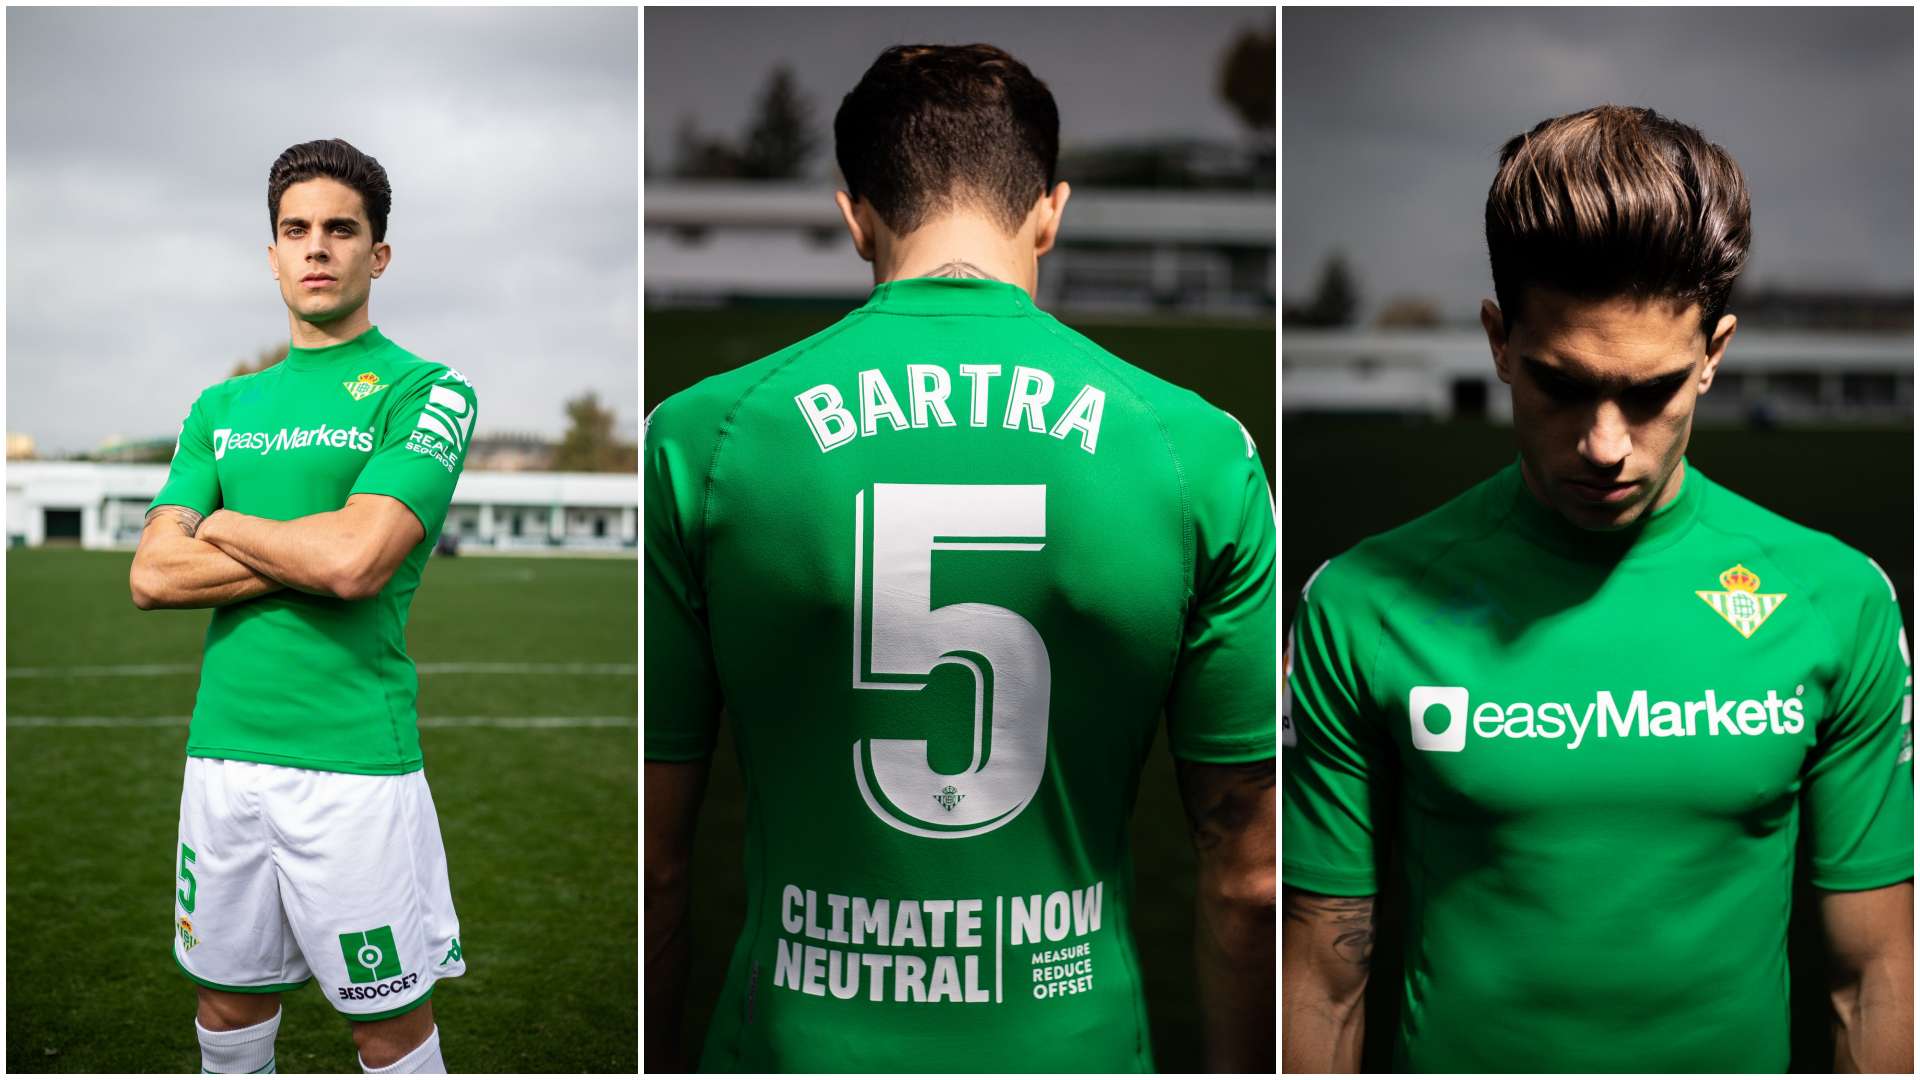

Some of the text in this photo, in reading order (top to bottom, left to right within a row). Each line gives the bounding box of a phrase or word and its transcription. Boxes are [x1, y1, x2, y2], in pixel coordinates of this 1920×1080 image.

[794, 363, 1107, 455] BARTRA
[228, 424, 373, 455] easyMarkets
[405, 442, 454, 472] SEGUROS
[410, 430, 458, 466] REALE
[853, 482, 1052, 839] 5
[1473, 689, 1804, 749] easyMarkets
[178, 842, 197, 914] 5
[781, 881, 1104, 948] CLIMATE NOW
[773, 937, 989, 1004] NEUTRAL
[1031, 942, 1091, 966] MEASURE
[1032, 958, 1093, 984] REDUCE
[338, 972, 418, 1001] BESOCCER
[1033, 975, 1093, 1000] OFFSET
